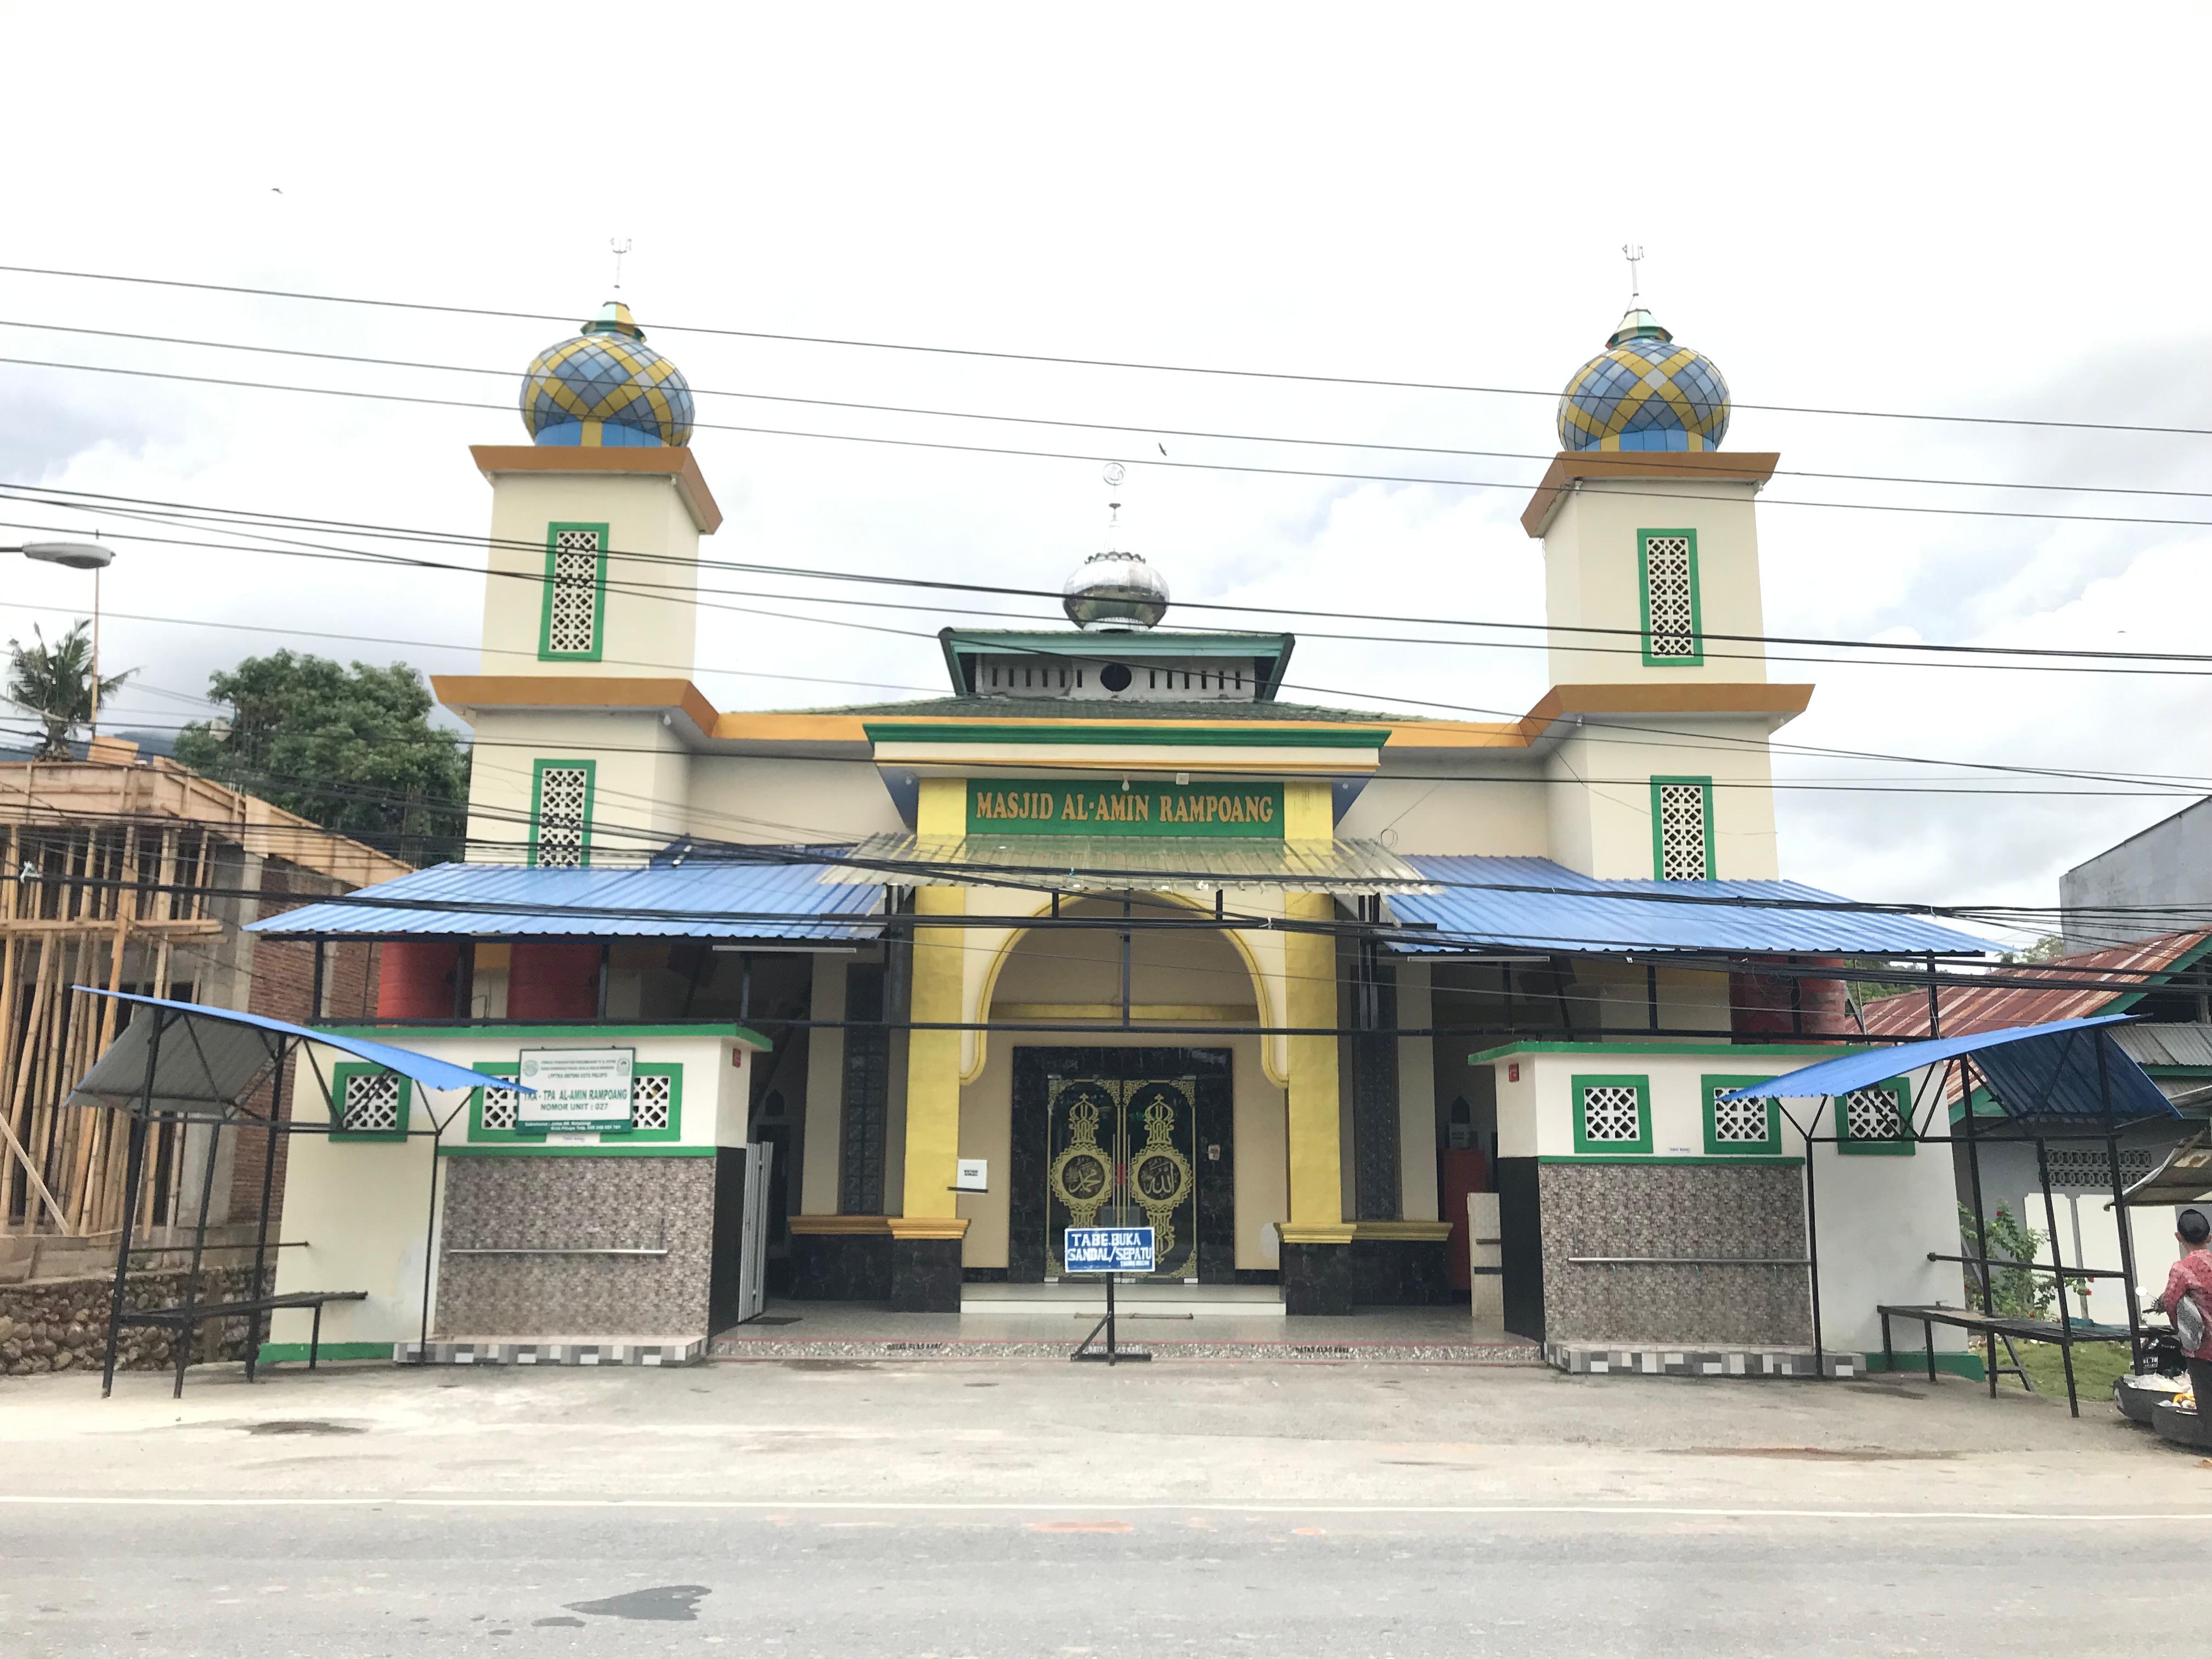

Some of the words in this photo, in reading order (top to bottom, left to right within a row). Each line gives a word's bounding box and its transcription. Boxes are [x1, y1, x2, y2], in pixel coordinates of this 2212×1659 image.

[976, 792, 1053, 819] MASJID
[1159, 795, 1273, 823] RAMPOANG
[543, 1090, 556, 1101] TPA
[558, 1089, 588, 1101] AL-AMIN
[589, 1088, 628, 1101] RAMPOANG
